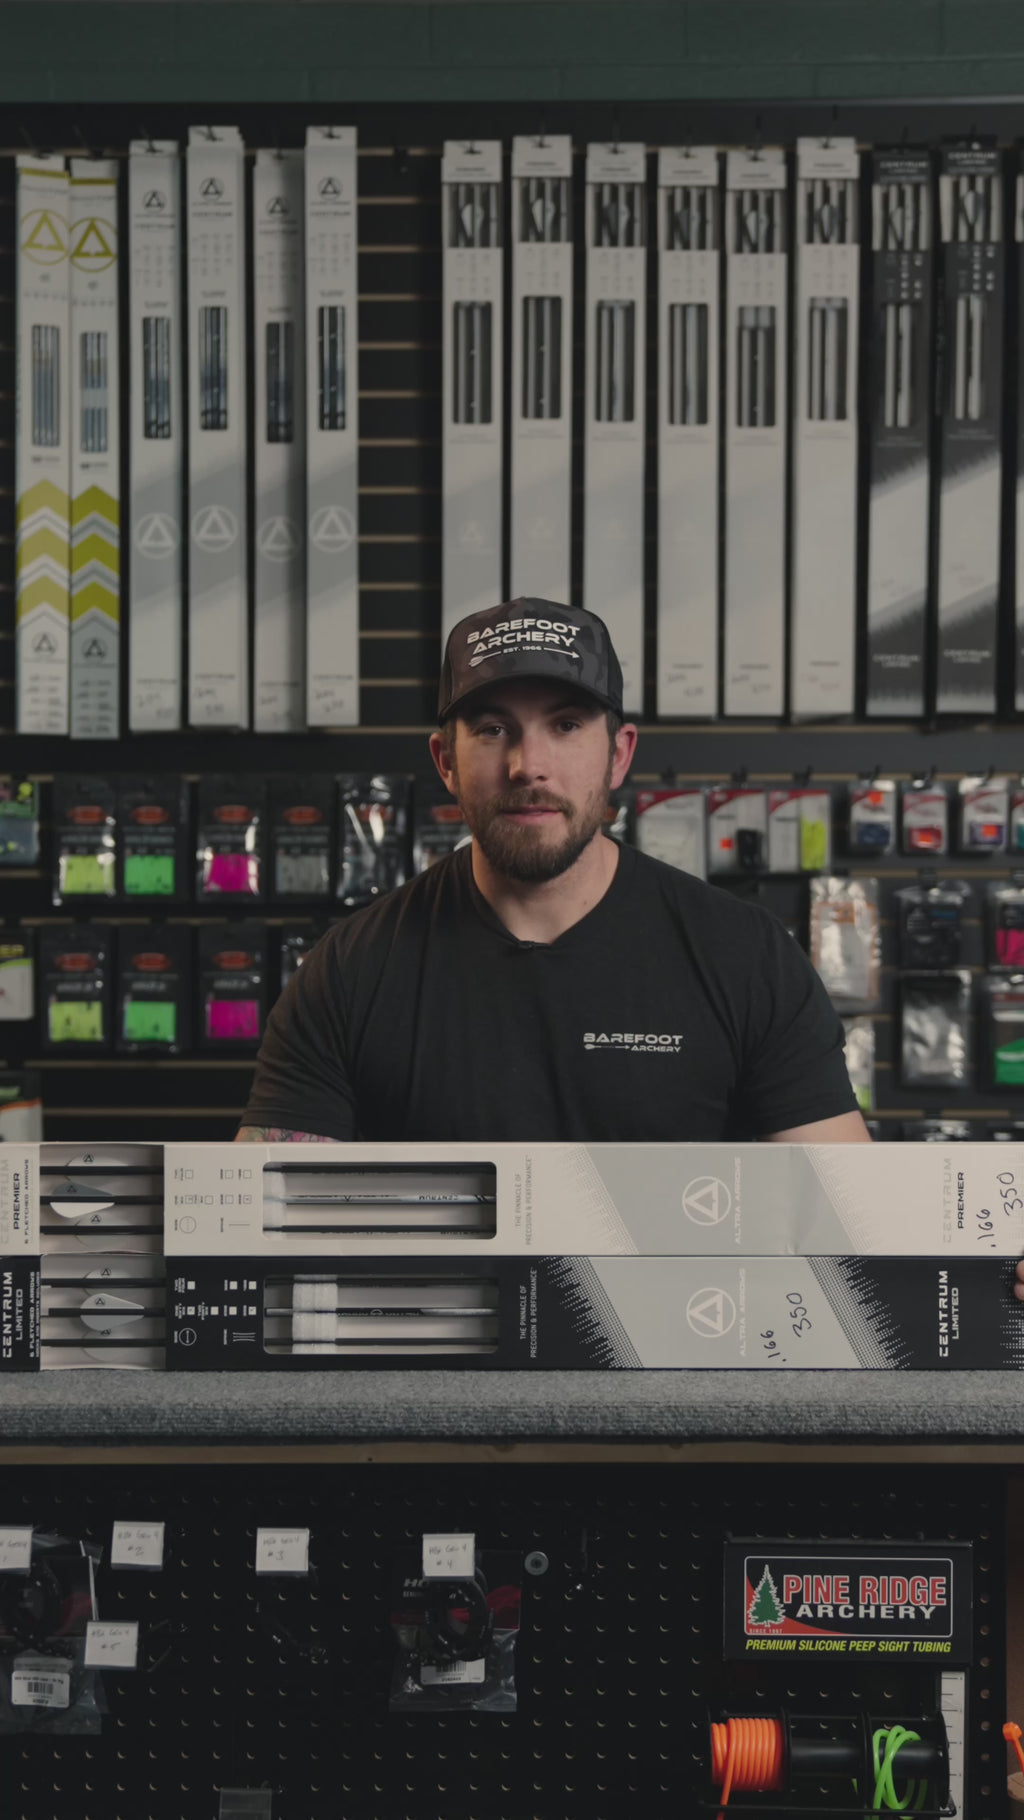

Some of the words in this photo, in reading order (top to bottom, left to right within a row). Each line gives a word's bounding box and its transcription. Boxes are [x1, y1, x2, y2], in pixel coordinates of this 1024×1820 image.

[467, 619, 580, 644] BAREFOOT
[472, 631, 575, 655] ARCHERY
[503, 646, 521, 654] EST.
[583, 1032, 683, 1045] BAREFOOT
[631, 1045, 681, 1053] ARCHERY
[515, 1174, 521, 1182] OF
[13, 1172, 21, 1230] PREMIER
[942, 1158, 952, 1243] CENTRUM
[996, 1172, 1024, 1216] 350
[976, 1208, 996, 1248] .166
[519, 1285, 527, 1294] OF
[3, 1271, 13, 1358] CENTRUM
[15, 1288, 23, 1341] LIMITED
[519, 1295, 527, 1326] PINNACLE
[786, 1292, 812, 1338] 350
[939, 1270, 948, 1358] CENTRUM
[951, 1287, 959, 1340] LIMITED
[519, 1327, 527, 1340] THE
[760, 1330, 787, 1362] .166
[783, 1574, 850, 1604] PINE
[859, 1576, 947, 1606] RIDGE
[796, 1605, 936, 1619] ARCHERY
[746, 1639, 796, 1650] PREMIUM
[798, 1639, 847, 1651] SILICONE
[849, 1640, 875, 1651] PEEP
[878, 1641, 910, 1652] SIGHT
[912, 1641, 951, 1653] TUBING
